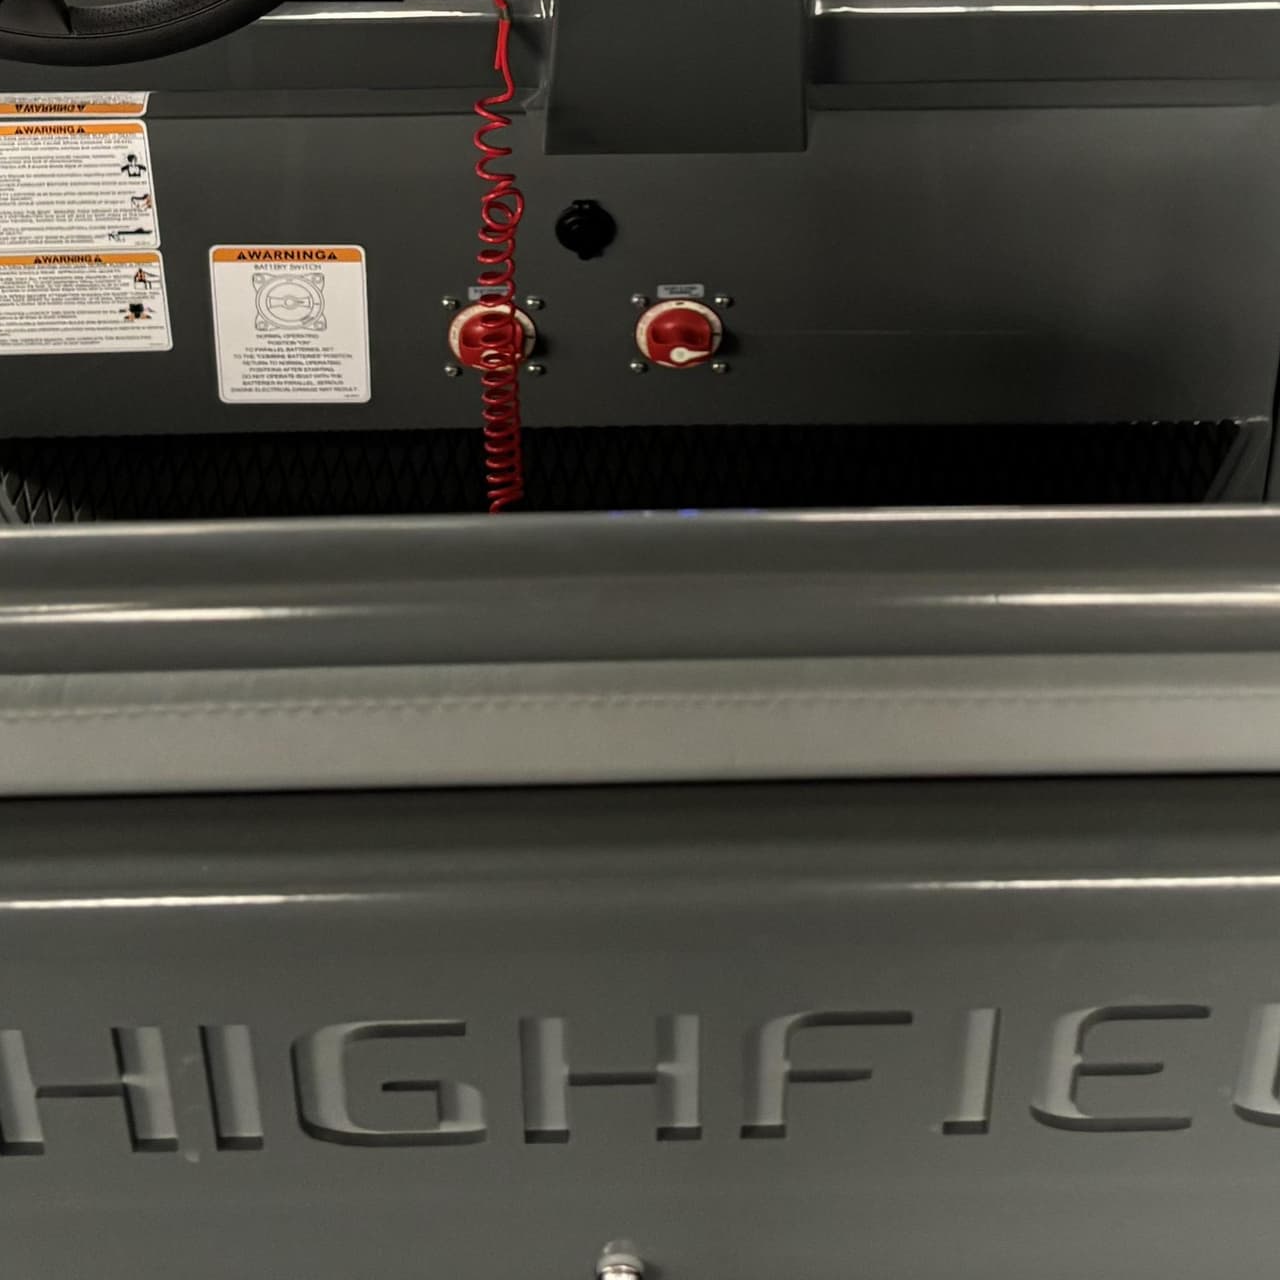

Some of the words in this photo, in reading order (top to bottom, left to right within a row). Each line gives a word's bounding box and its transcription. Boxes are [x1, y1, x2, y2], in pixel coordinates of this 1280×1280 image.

[23, 124, 75, 135] WARNING
[41, 254, 93, 265] WARNING
[247, 250, 327, 260] WARNING
